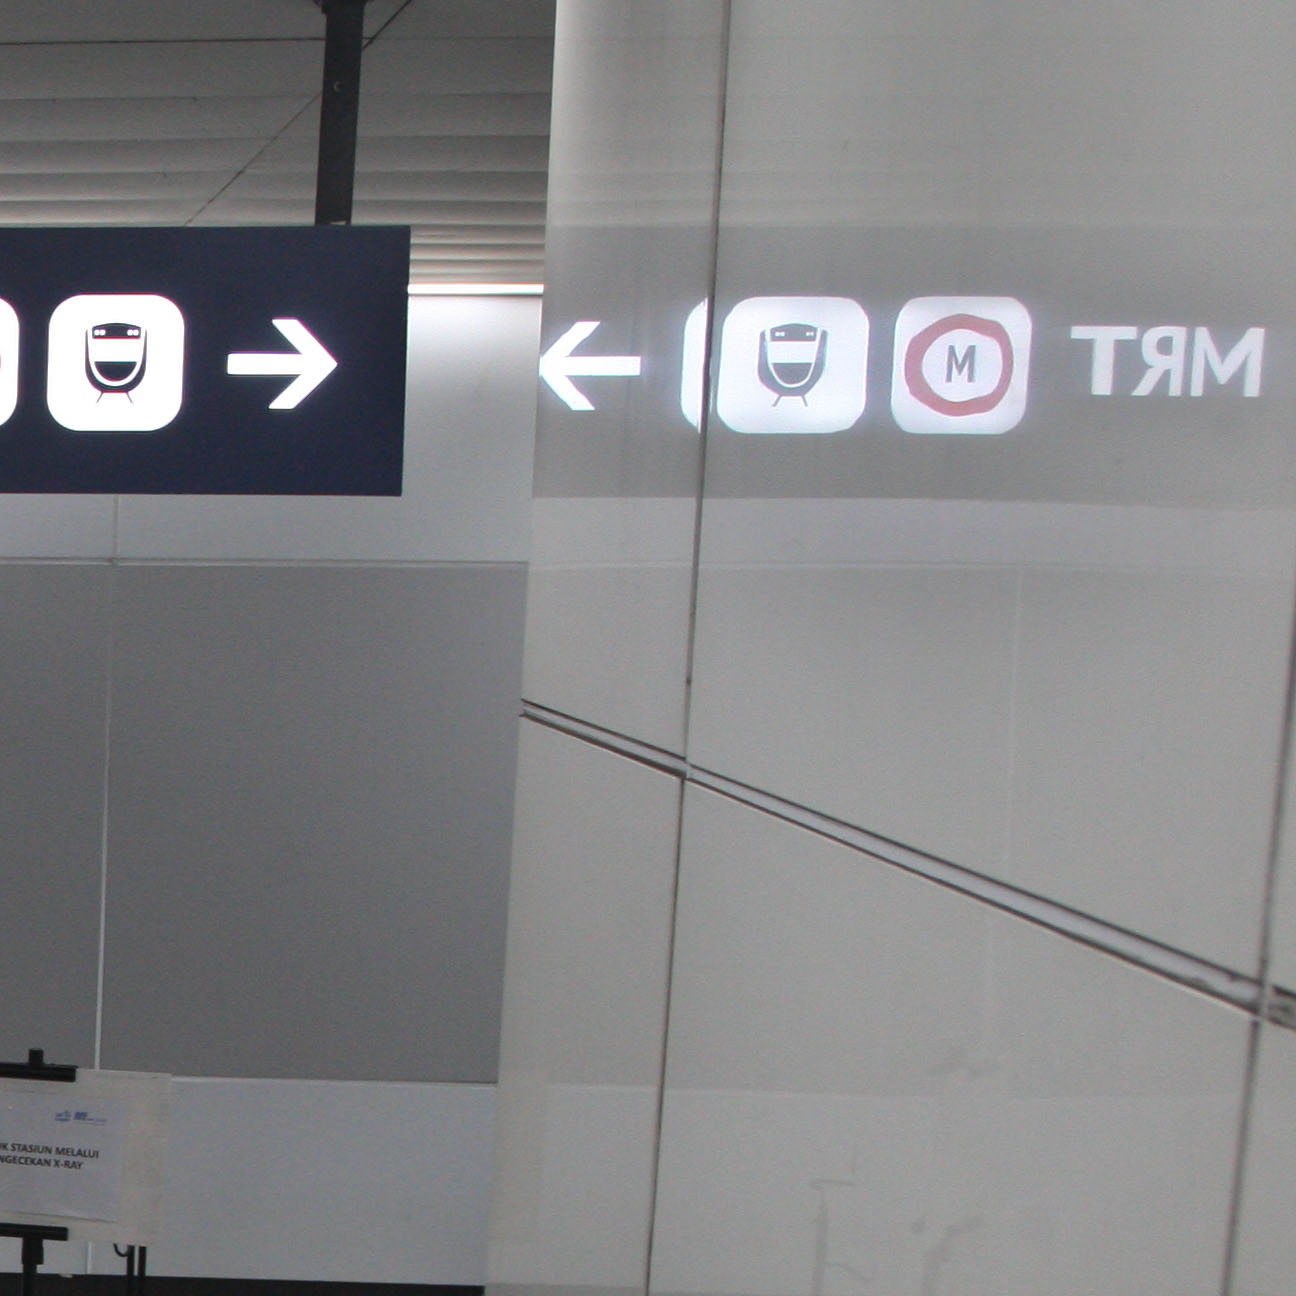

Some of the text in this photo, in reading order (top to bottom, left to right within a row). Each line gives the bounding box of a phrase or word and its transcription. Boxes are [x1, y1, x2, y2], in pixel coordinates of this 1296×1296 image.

[10, 1143, 52, 1155] STASIUN
[55, 1146, 100, 1159] MELALUI
[54, 1160, 84, 1170] X-RAY
